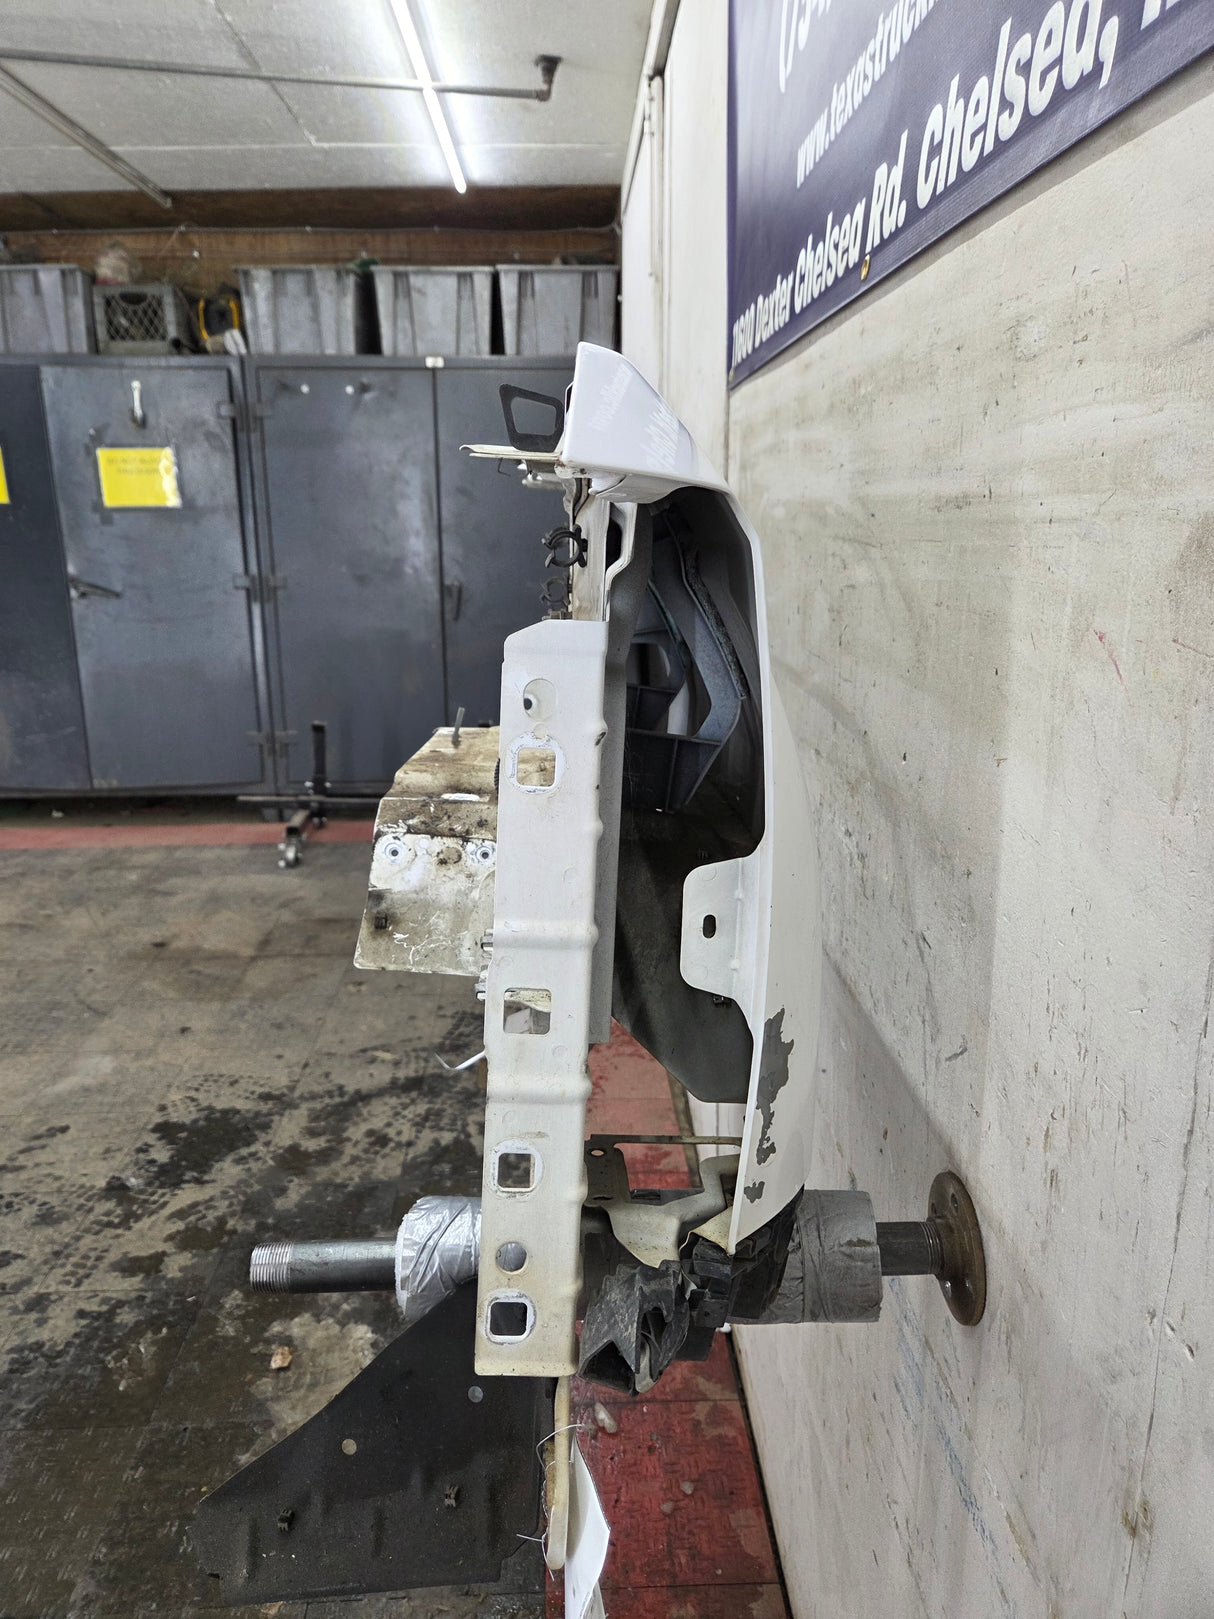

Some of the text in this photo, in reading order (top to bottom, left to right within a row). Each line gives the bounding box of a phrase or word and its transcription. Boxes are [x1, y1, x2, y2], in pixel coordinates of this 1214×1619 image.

[754, 270, 795, 349] Dexter
[794, 197, 866, 314] Chelsea
[864, 128, 909, 254] Rd.
[916, 0, 1119, 209] Chelsea,
